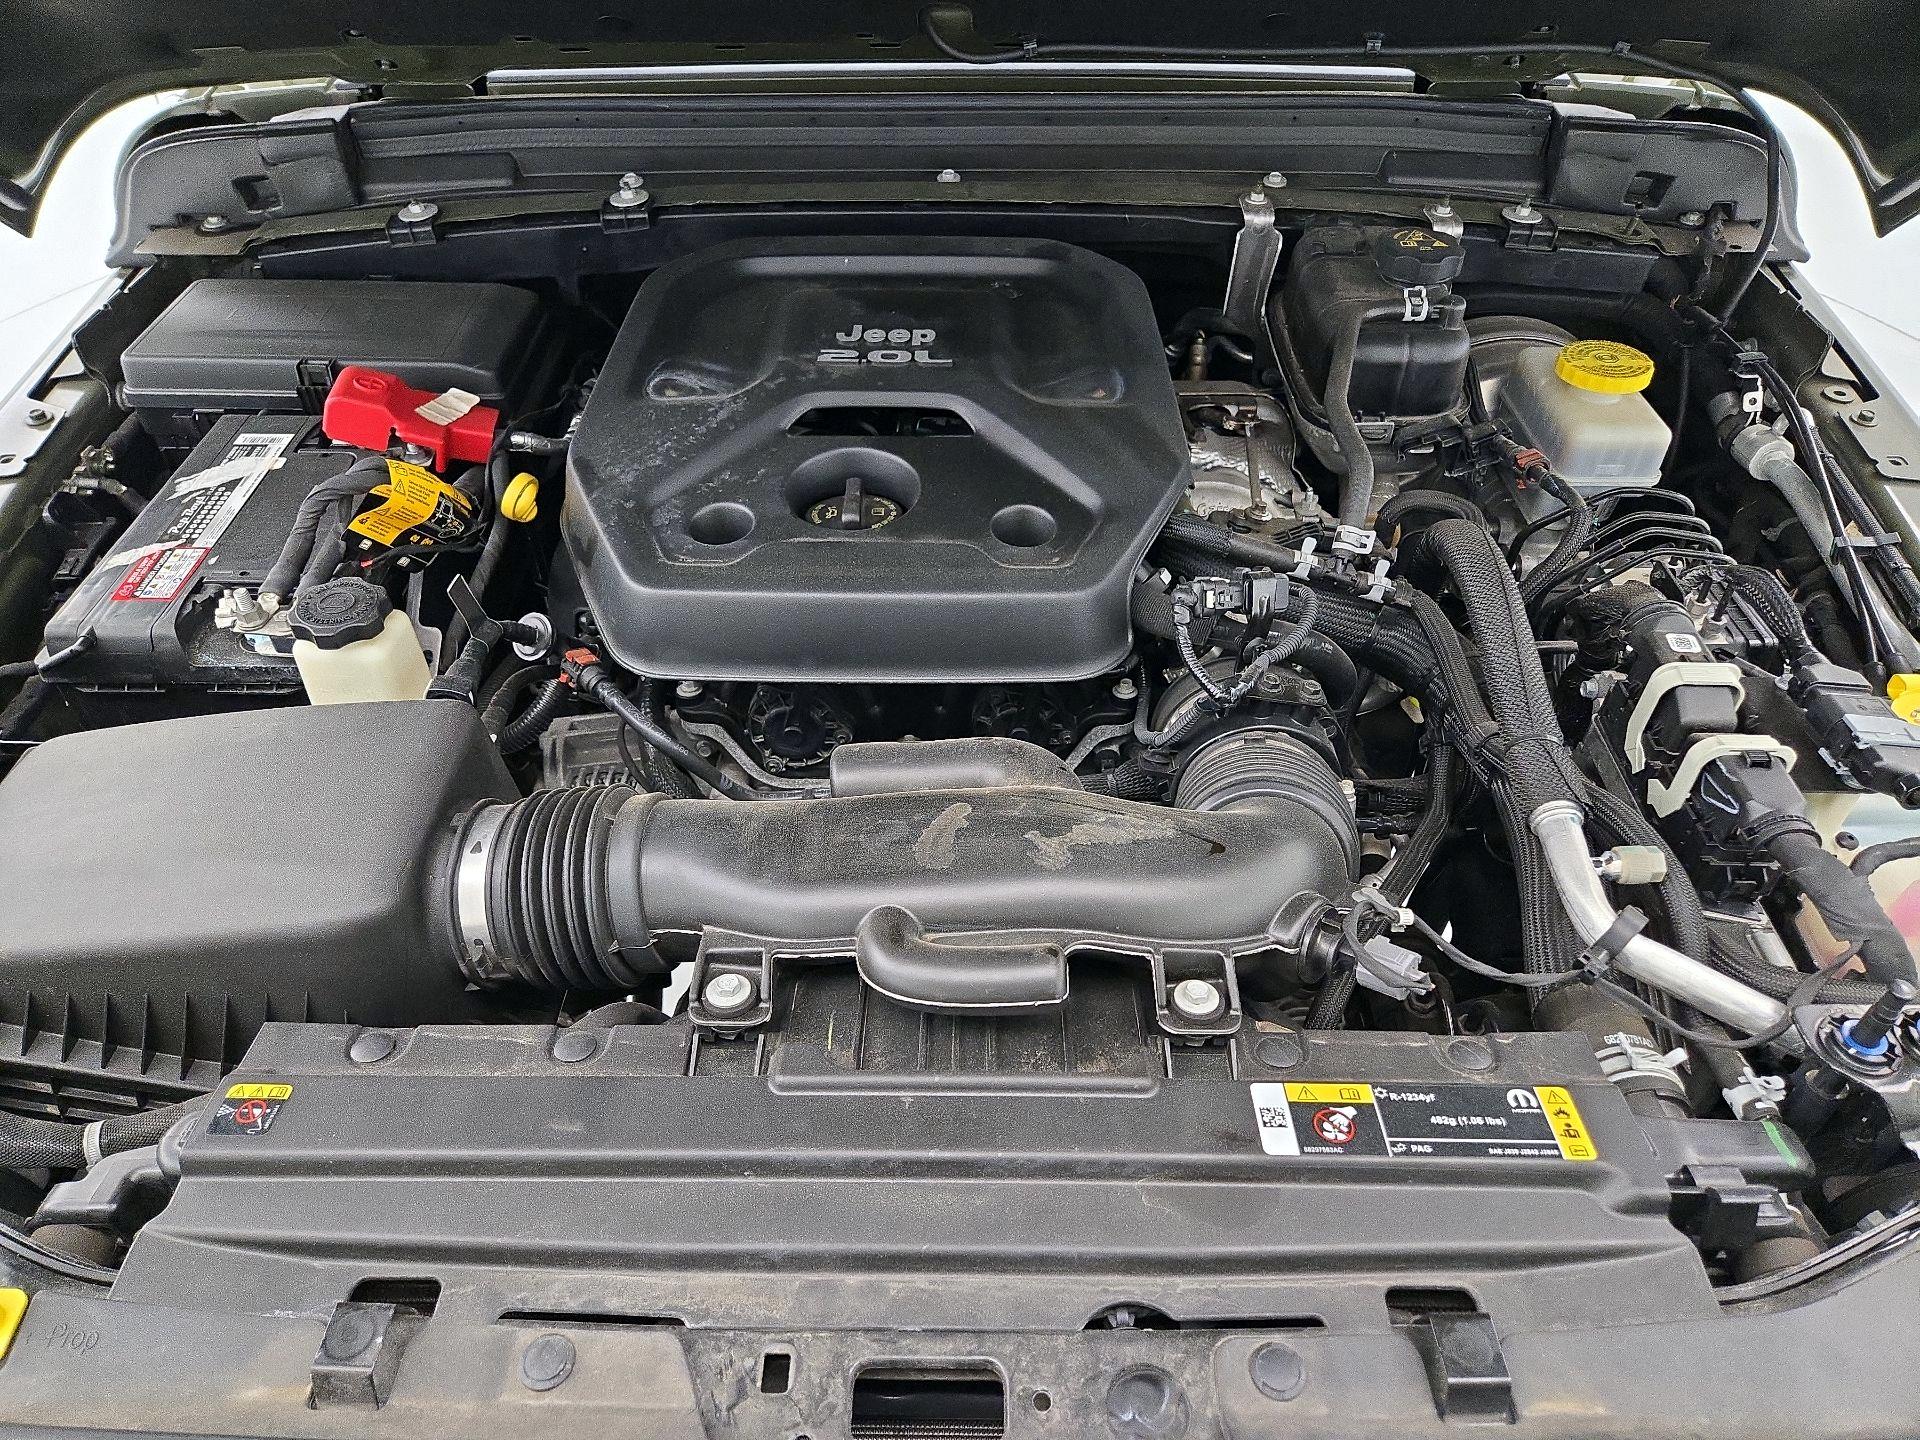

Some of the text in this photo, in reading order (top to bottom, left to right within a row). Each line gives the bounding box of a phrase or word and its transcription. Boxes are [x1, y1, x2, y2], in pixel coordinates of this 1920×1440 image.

[836, 324, 936, 346] Jeep
[816, 349, 953, 363] 2.0L
[167, 515, 191, 534] Pep
[1389, 1093, 1436, 1103] R-1234yf
[1485, 1116, 1507, 1128] lbs)
[1410, 1144, 1434, 1153] PAG
[46, 1323, 99, 1355] Prop
